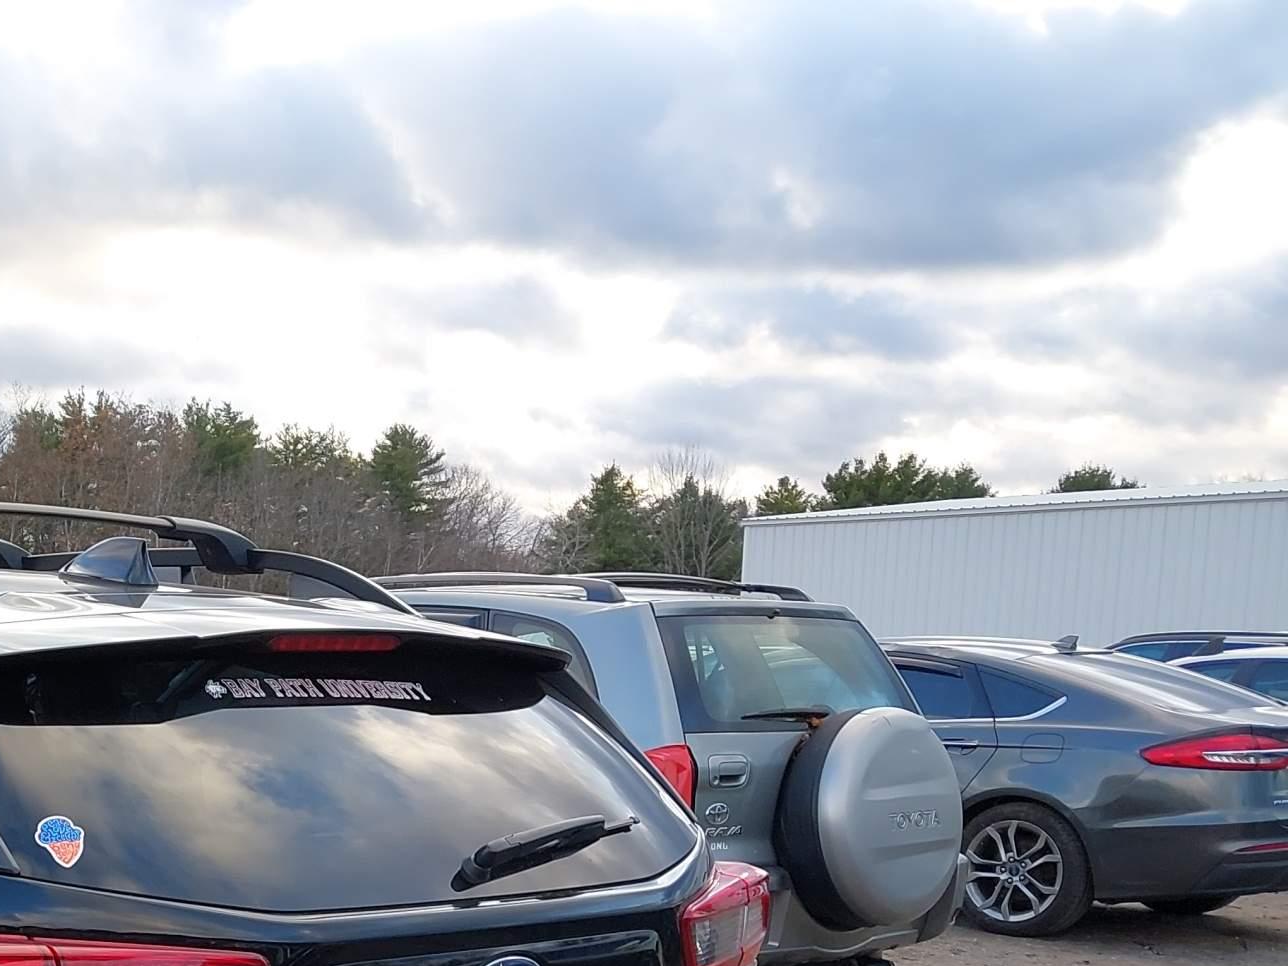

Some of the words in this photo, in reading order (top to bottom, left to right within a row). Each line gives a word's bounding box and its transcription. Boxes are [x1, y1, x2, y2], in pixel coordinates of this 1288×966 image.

[221, 678, 266, 699] BAY
[264, 678, 324, 699] PATH
[316, 678, 432, 701] UNIVERSITY
[887, 809, 941, 829] TOYOTA
